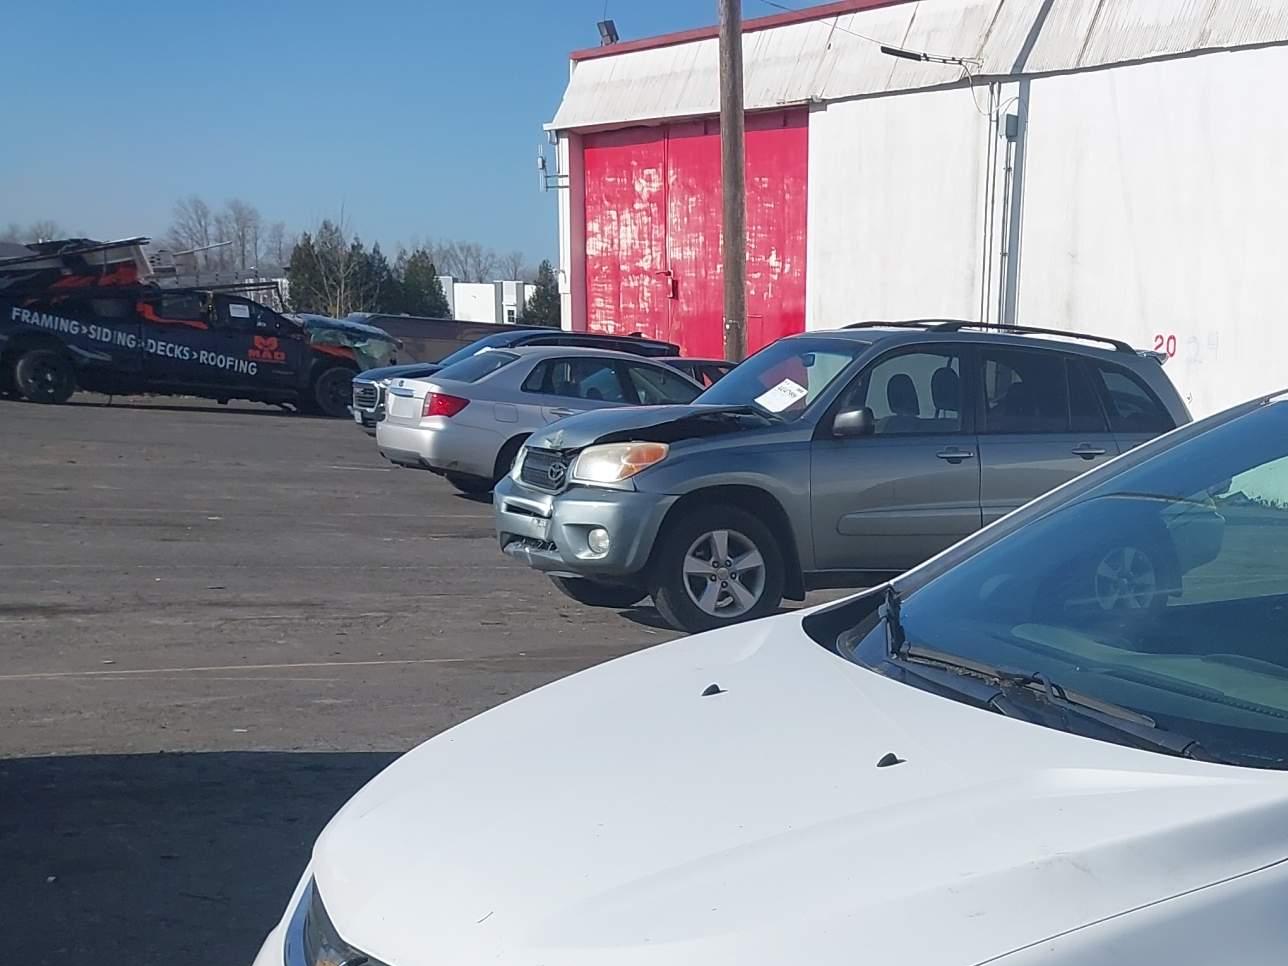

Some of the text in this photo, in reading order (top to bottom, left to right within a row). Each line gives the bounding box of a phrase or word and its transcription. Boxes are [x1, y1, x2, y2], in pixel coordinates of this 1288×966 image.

[11, 306, 258, 375] FRAMING SIDING DECKS ROOFING
[1154, 334, 1177, 358] 20
